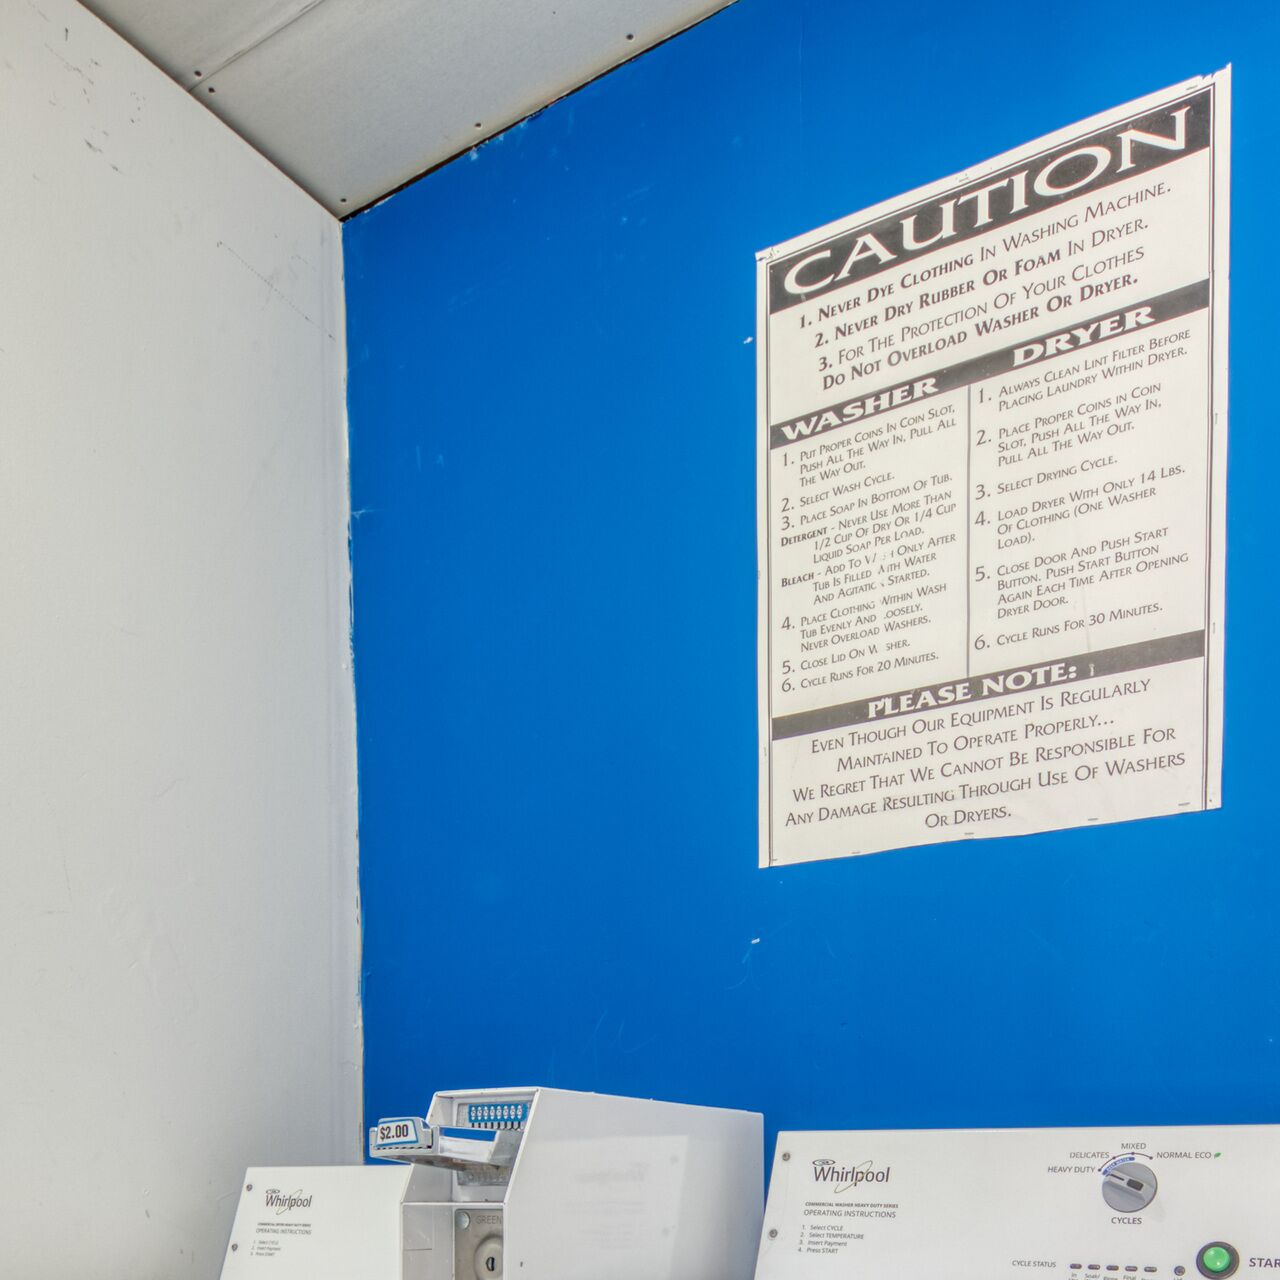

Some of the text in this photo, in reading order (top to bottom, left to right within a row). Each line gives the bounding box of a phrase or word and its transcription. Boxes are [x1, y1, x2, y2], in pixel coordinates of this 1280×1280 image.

[784, 106, 1190, 294] CAUTION
[1013, 306, 1155, 367] DRYER
[781, 377, 939, 440] WASHER
[868, 662, 1077, 719] PLEASE NOTE:
[380, 1124, 408, 1141] $2.00
[813, 1167, 890, 1186] Whirlpool
[266, 1195, 312, 1210] Whirlpool
[844, 1210, 896, 1218] INSTRUCTIONS
[1033, 1260, 1056, 1268] STATUS
